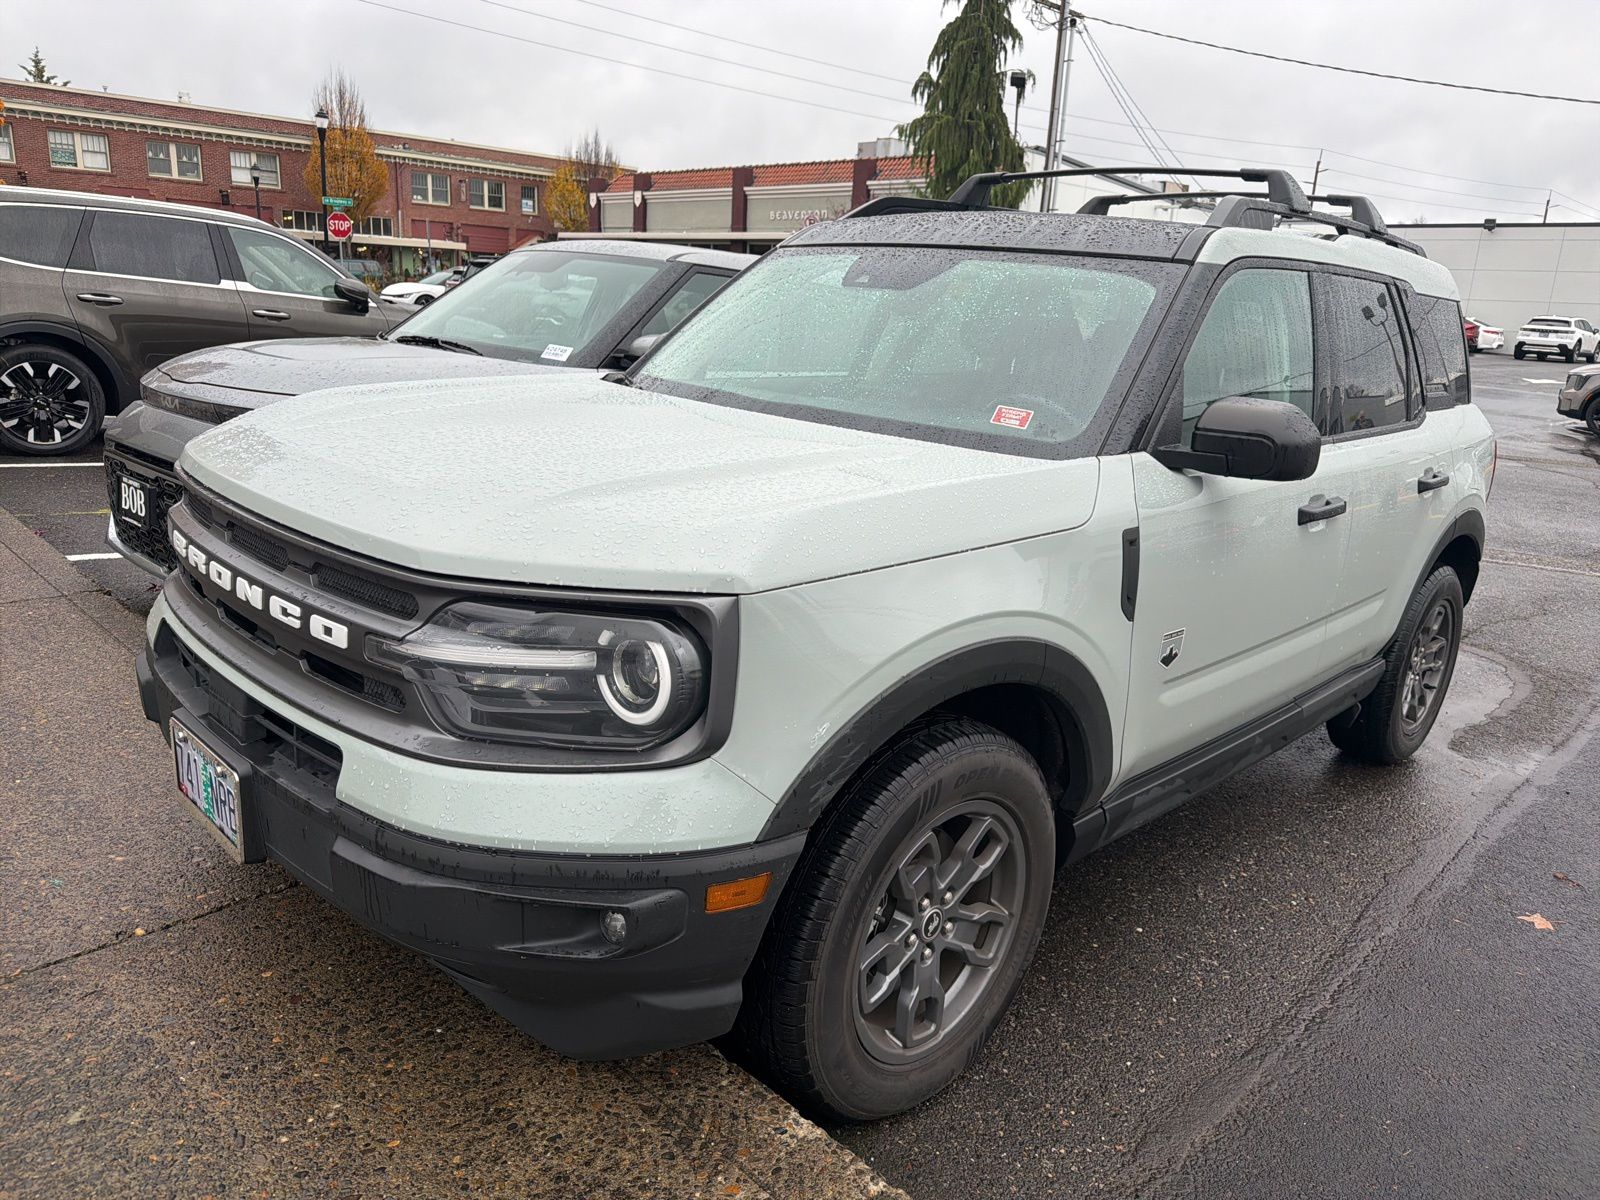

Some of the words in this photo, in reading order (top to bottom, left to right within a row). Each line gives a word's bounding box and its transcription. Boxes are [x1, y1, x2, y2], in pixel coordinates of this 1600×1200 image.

[329, 220, 351, 231] STOP
[121, 482, 146, 517] BOB
[173, 529, 349, 649] BRONCO
